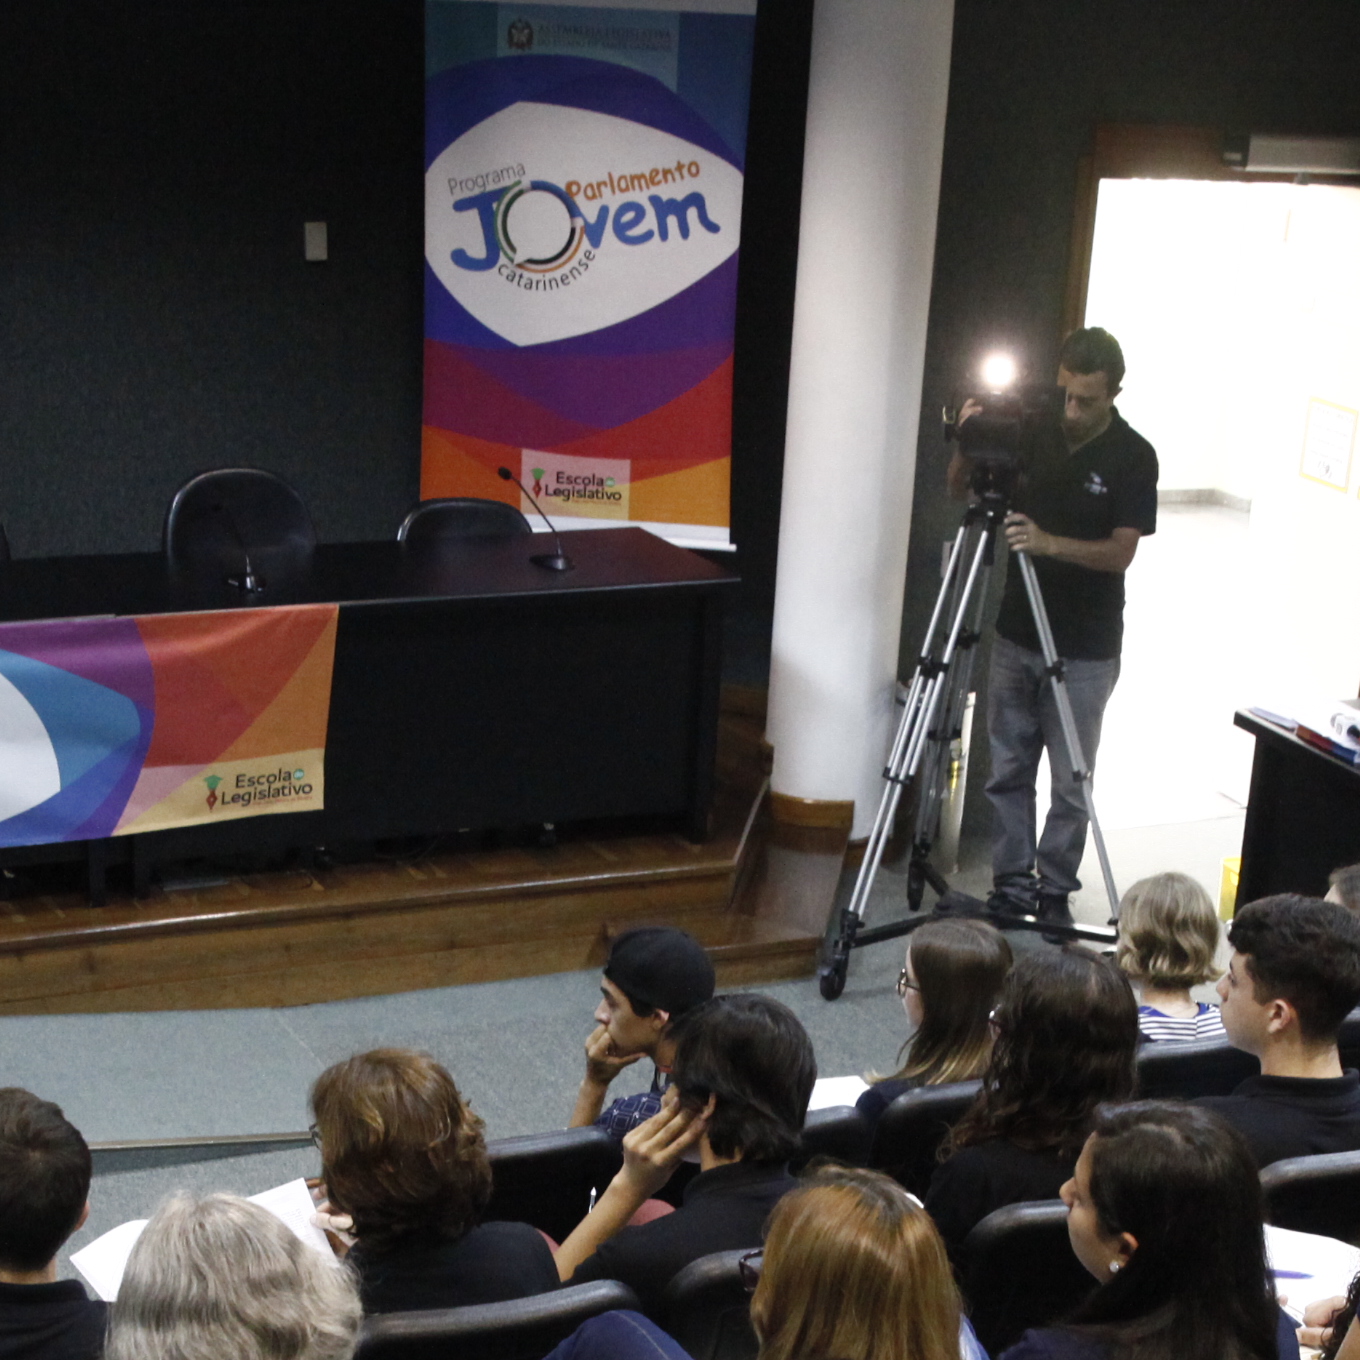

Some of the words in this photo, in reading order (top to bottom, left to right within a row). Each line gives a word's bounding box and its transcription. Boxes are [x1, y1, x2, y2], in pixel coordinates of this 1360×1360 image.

[448, 162, 527, 196] Programa
[565, 160, 701, 202] Parlamento
[556, 471, 604, 487] Escola
[545, 484, 622, 502] Legislativo
[235, 768, 292, 789] Escola
[221, 781, 313, 807] Legislativo
